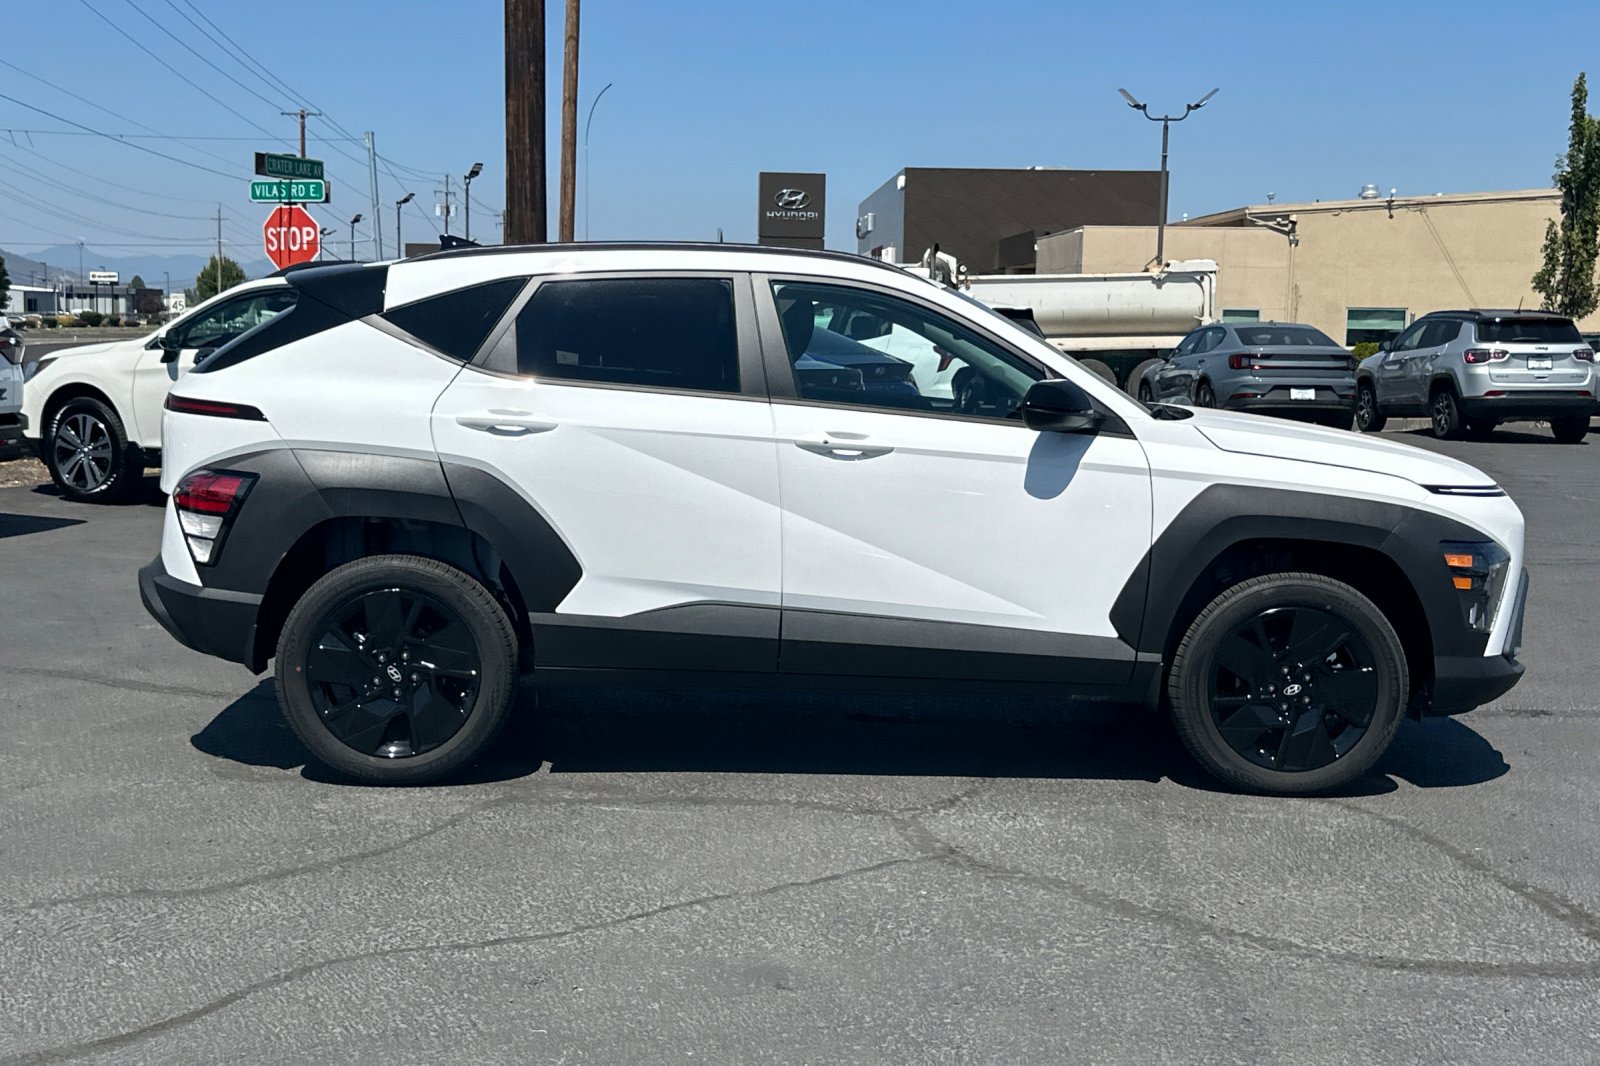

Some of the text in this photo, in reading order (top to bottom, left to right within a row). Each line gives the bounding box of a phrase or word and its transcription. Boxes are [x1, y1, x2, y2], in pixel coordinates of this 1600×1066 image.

[268, 158, 293, 174] CRATER
[295, 161, 312, 177] LAKE
[254, 184, 286, 197] VILAS
[291, 184, 305, 197] RD
[766, 211, 818, 220] HYUNDAI
[267, 226, 315, 252] STOP
[172, 300, 184, 311] 45
